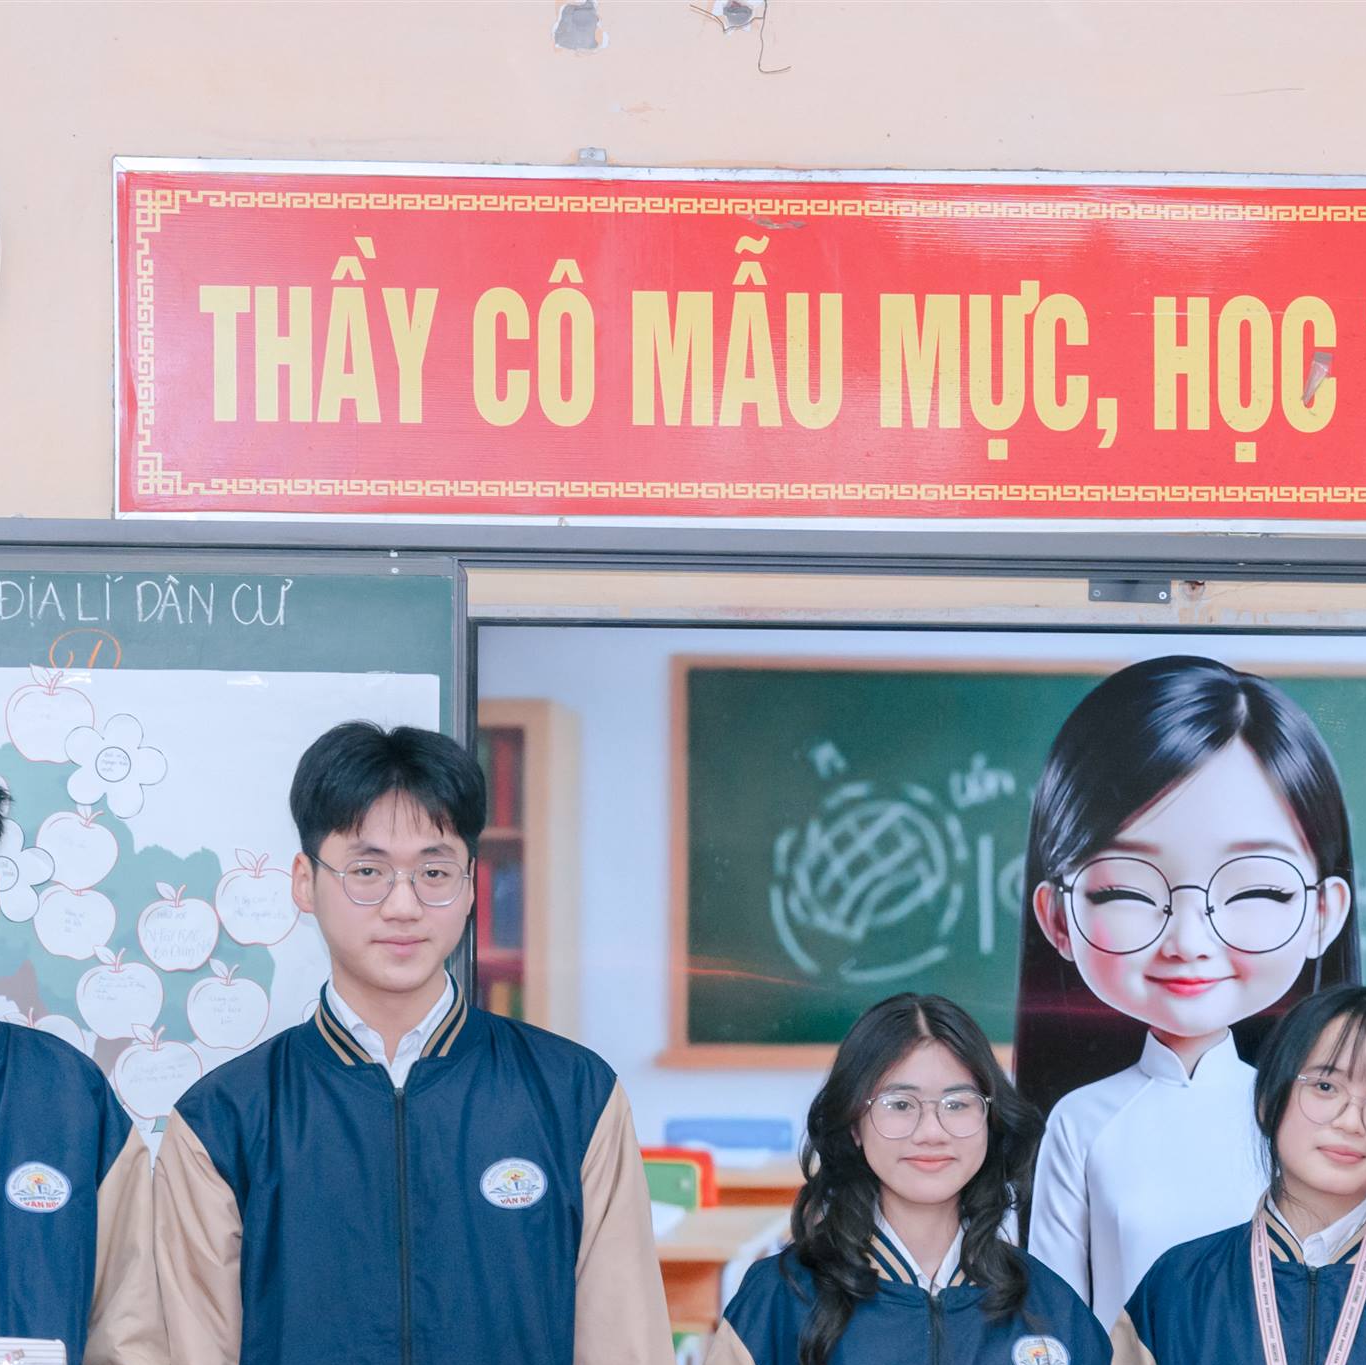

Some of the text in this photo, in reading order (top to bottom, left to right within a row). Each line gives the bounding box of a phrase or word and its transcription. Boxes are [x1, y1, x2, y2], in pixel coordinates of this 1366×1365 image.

[199, 236, 439, 425] THẦY
[472, 258, 595, 427] CÔ
[632, 234, 842, 431] MẪU
[879, 280, 1119, 460] MỰC,
[1152, 294, 1337, 463] HỌC
[231, 578, 293, 626] CƯ
